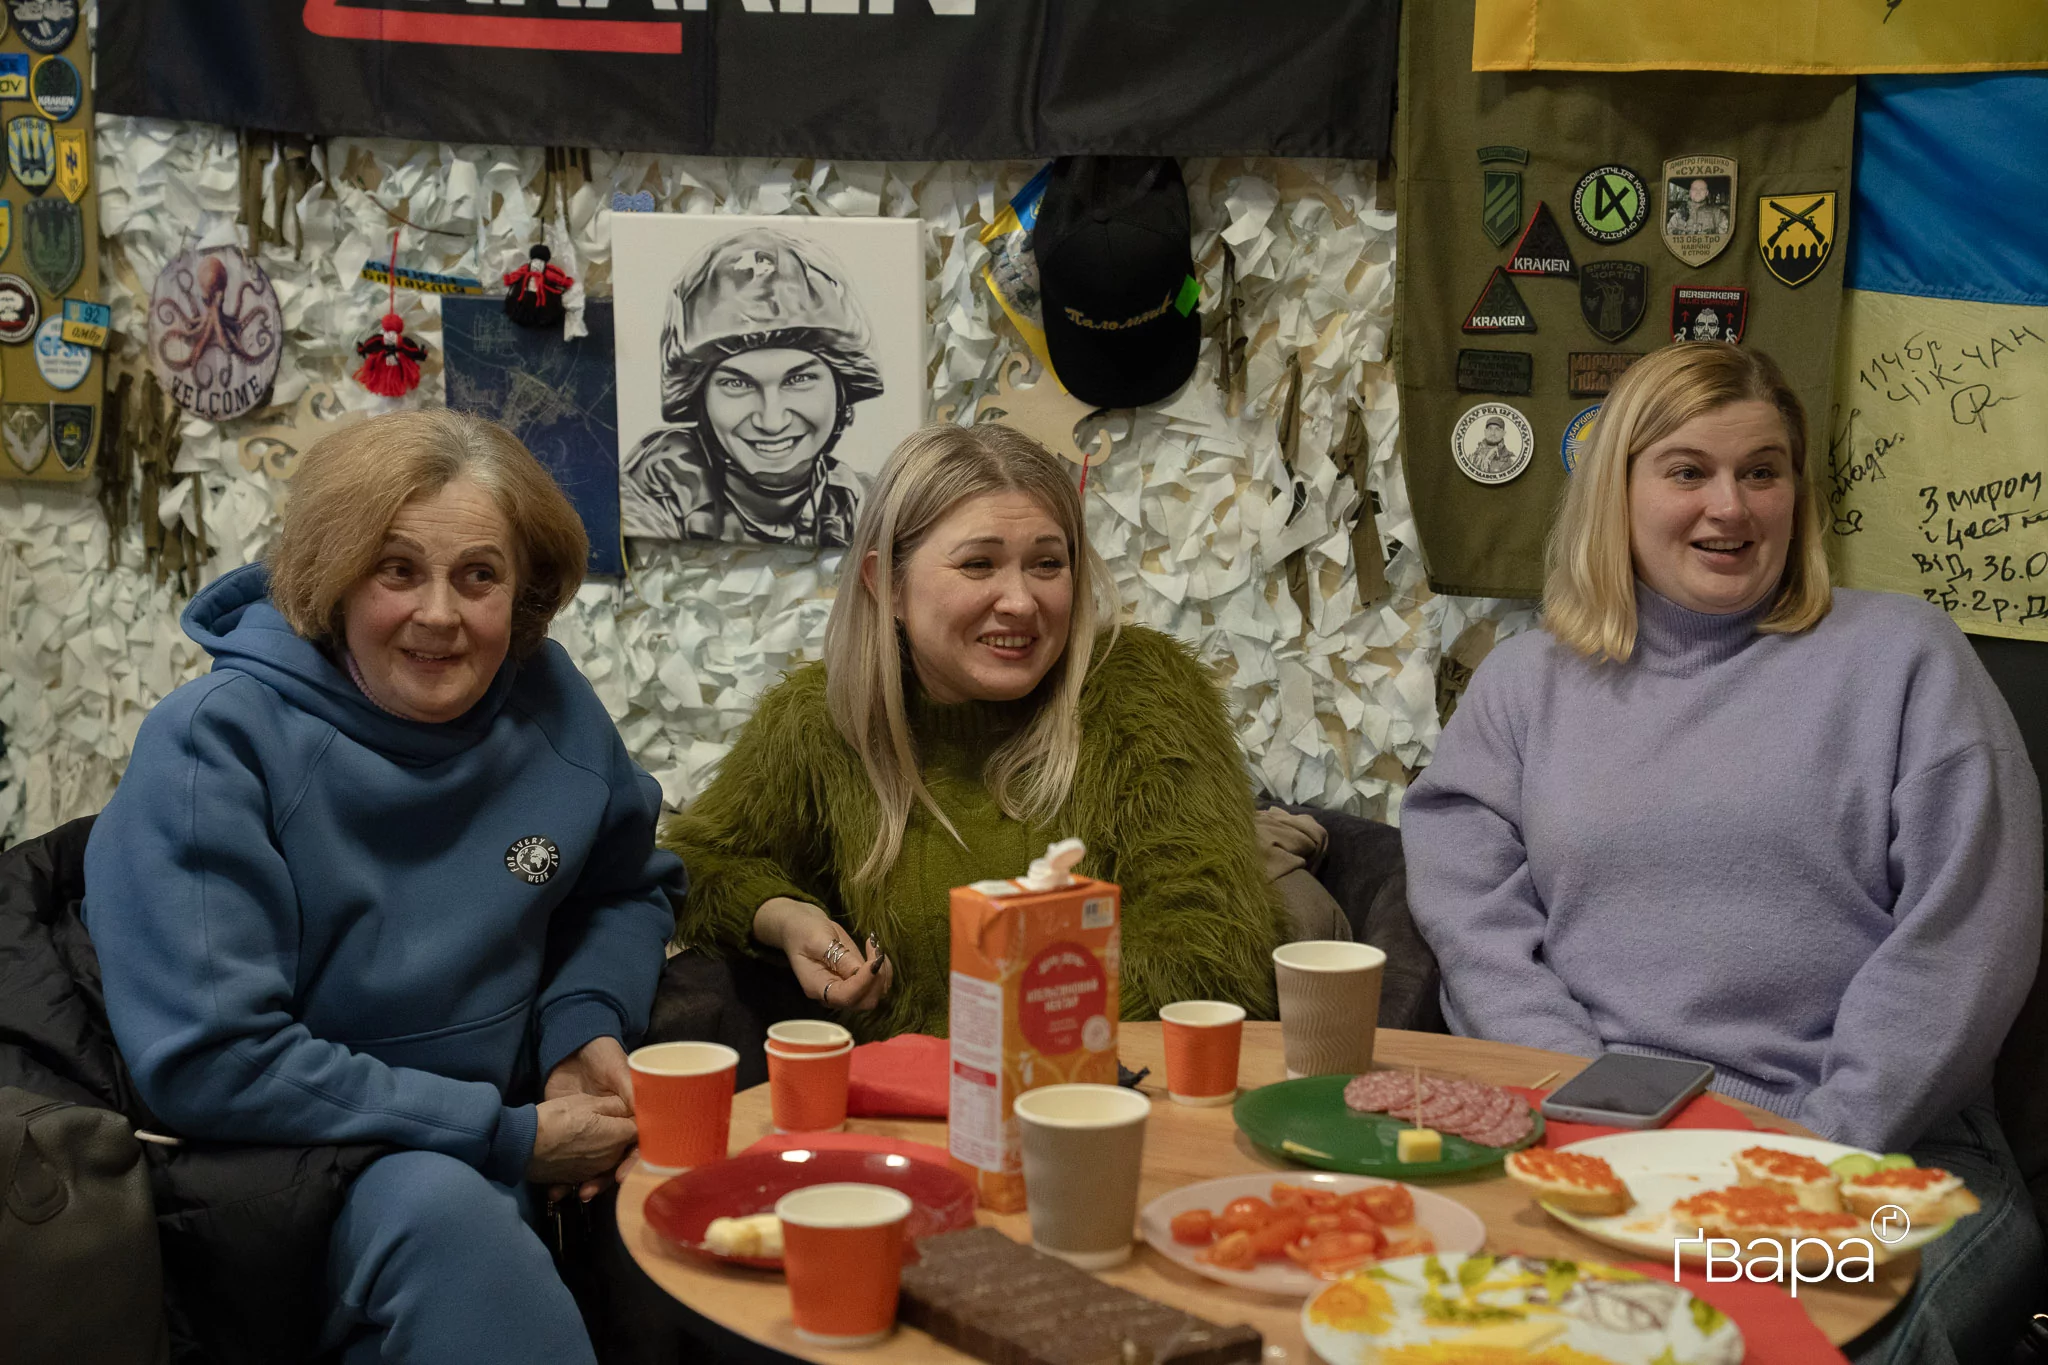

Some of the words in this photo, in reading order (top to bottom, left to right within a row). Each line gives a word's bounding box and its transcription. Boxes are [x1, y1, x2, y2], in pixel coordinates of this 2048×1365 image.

[1574, 187, 1599, 237] FOUNDATION
[1600, 221, 1638, 240] CHARITY
[1514, 257, 1570, 272] KRAKEN
[1586, 262, 1641, 273] БРИГАДА
[1679, 290, 1740, 300] BERSERKERS
[84, 307, 100, 324] 92
[1472, 316, 1525, 327] KRAKEN
[171, 375, 263, 416] WELCOME
[1568, 408, 1600, 439] ХАРКІВС
[511, 837, 546, 852] EVERY
[506, 856, 520, 873] FOR
[547, 845, 559, 868] DAY
[528, 872, 549, 883] WEAR
